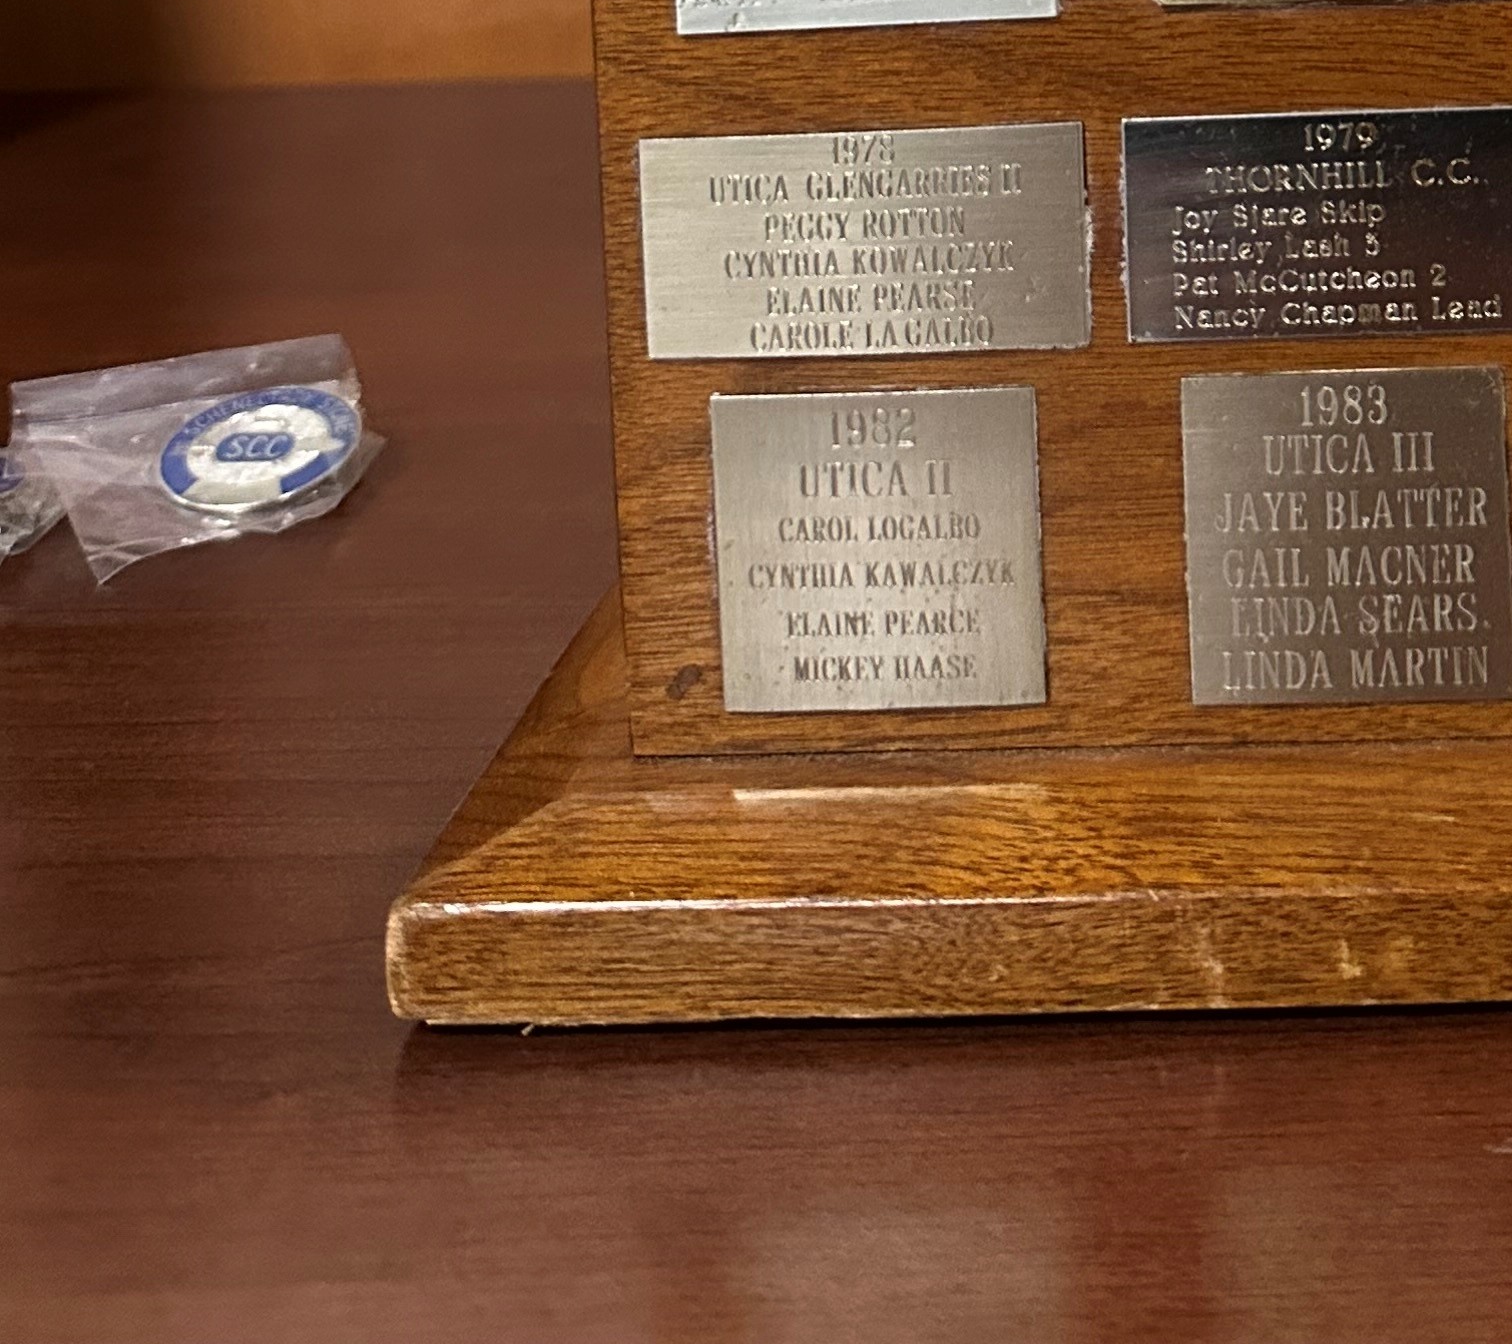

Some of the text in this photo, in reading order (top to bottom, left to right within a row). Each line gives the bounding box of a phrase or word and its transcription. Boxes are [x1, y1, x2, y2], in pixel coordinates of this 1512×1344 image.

[832, 134, 895, 166] 1978
[1304, 122, 1376, 151] 1979
[709, 163, 1022, 205] UTICA II
[1206, 159, 1481, 194] THORNHILL C.C.
[862, 208, 964, 239] ROTTON
[1172, 200, 1386, 236] Joy Skip
[724, 241, 1014, 279] CYNTHIA KOWALCZYK
[1172, 233, 1351, 265] Shirley Lash
[767, 280, 975, 316] ELAINE PEARSE
[1173, 265, 1447, 296] Pat McCutcheon 2
[1174, 294, 1502, 330] Nancy Chapman Lead
[751, 320, 853, 353] CAROLE
[1300, 385, 1388, 427] 1983
[225, 434, 288, 459] SCC
[831, 408, 916, 450] 1982
[1262, 432, 1435, 474] UTICA III
[800, 460, 953, 497] UTICA II
[778, 513, 981, 543] CAROL LOGALBO
[1215, 487, 1488, 533] JAYE BLATTER
[749, 561, 1016, 589] CYNTHIA KAWALCZYK
[1223, 547, 1309, 588] GAIL
[786, 610, 980, 638] ELAINE PEARCE
[1231, 592, 1478, 636] LINDA SEARS
[794, 655, 977, 682] MICKEY HAASE
[1222, 647, 1488, 690] LINDA MARTIN
